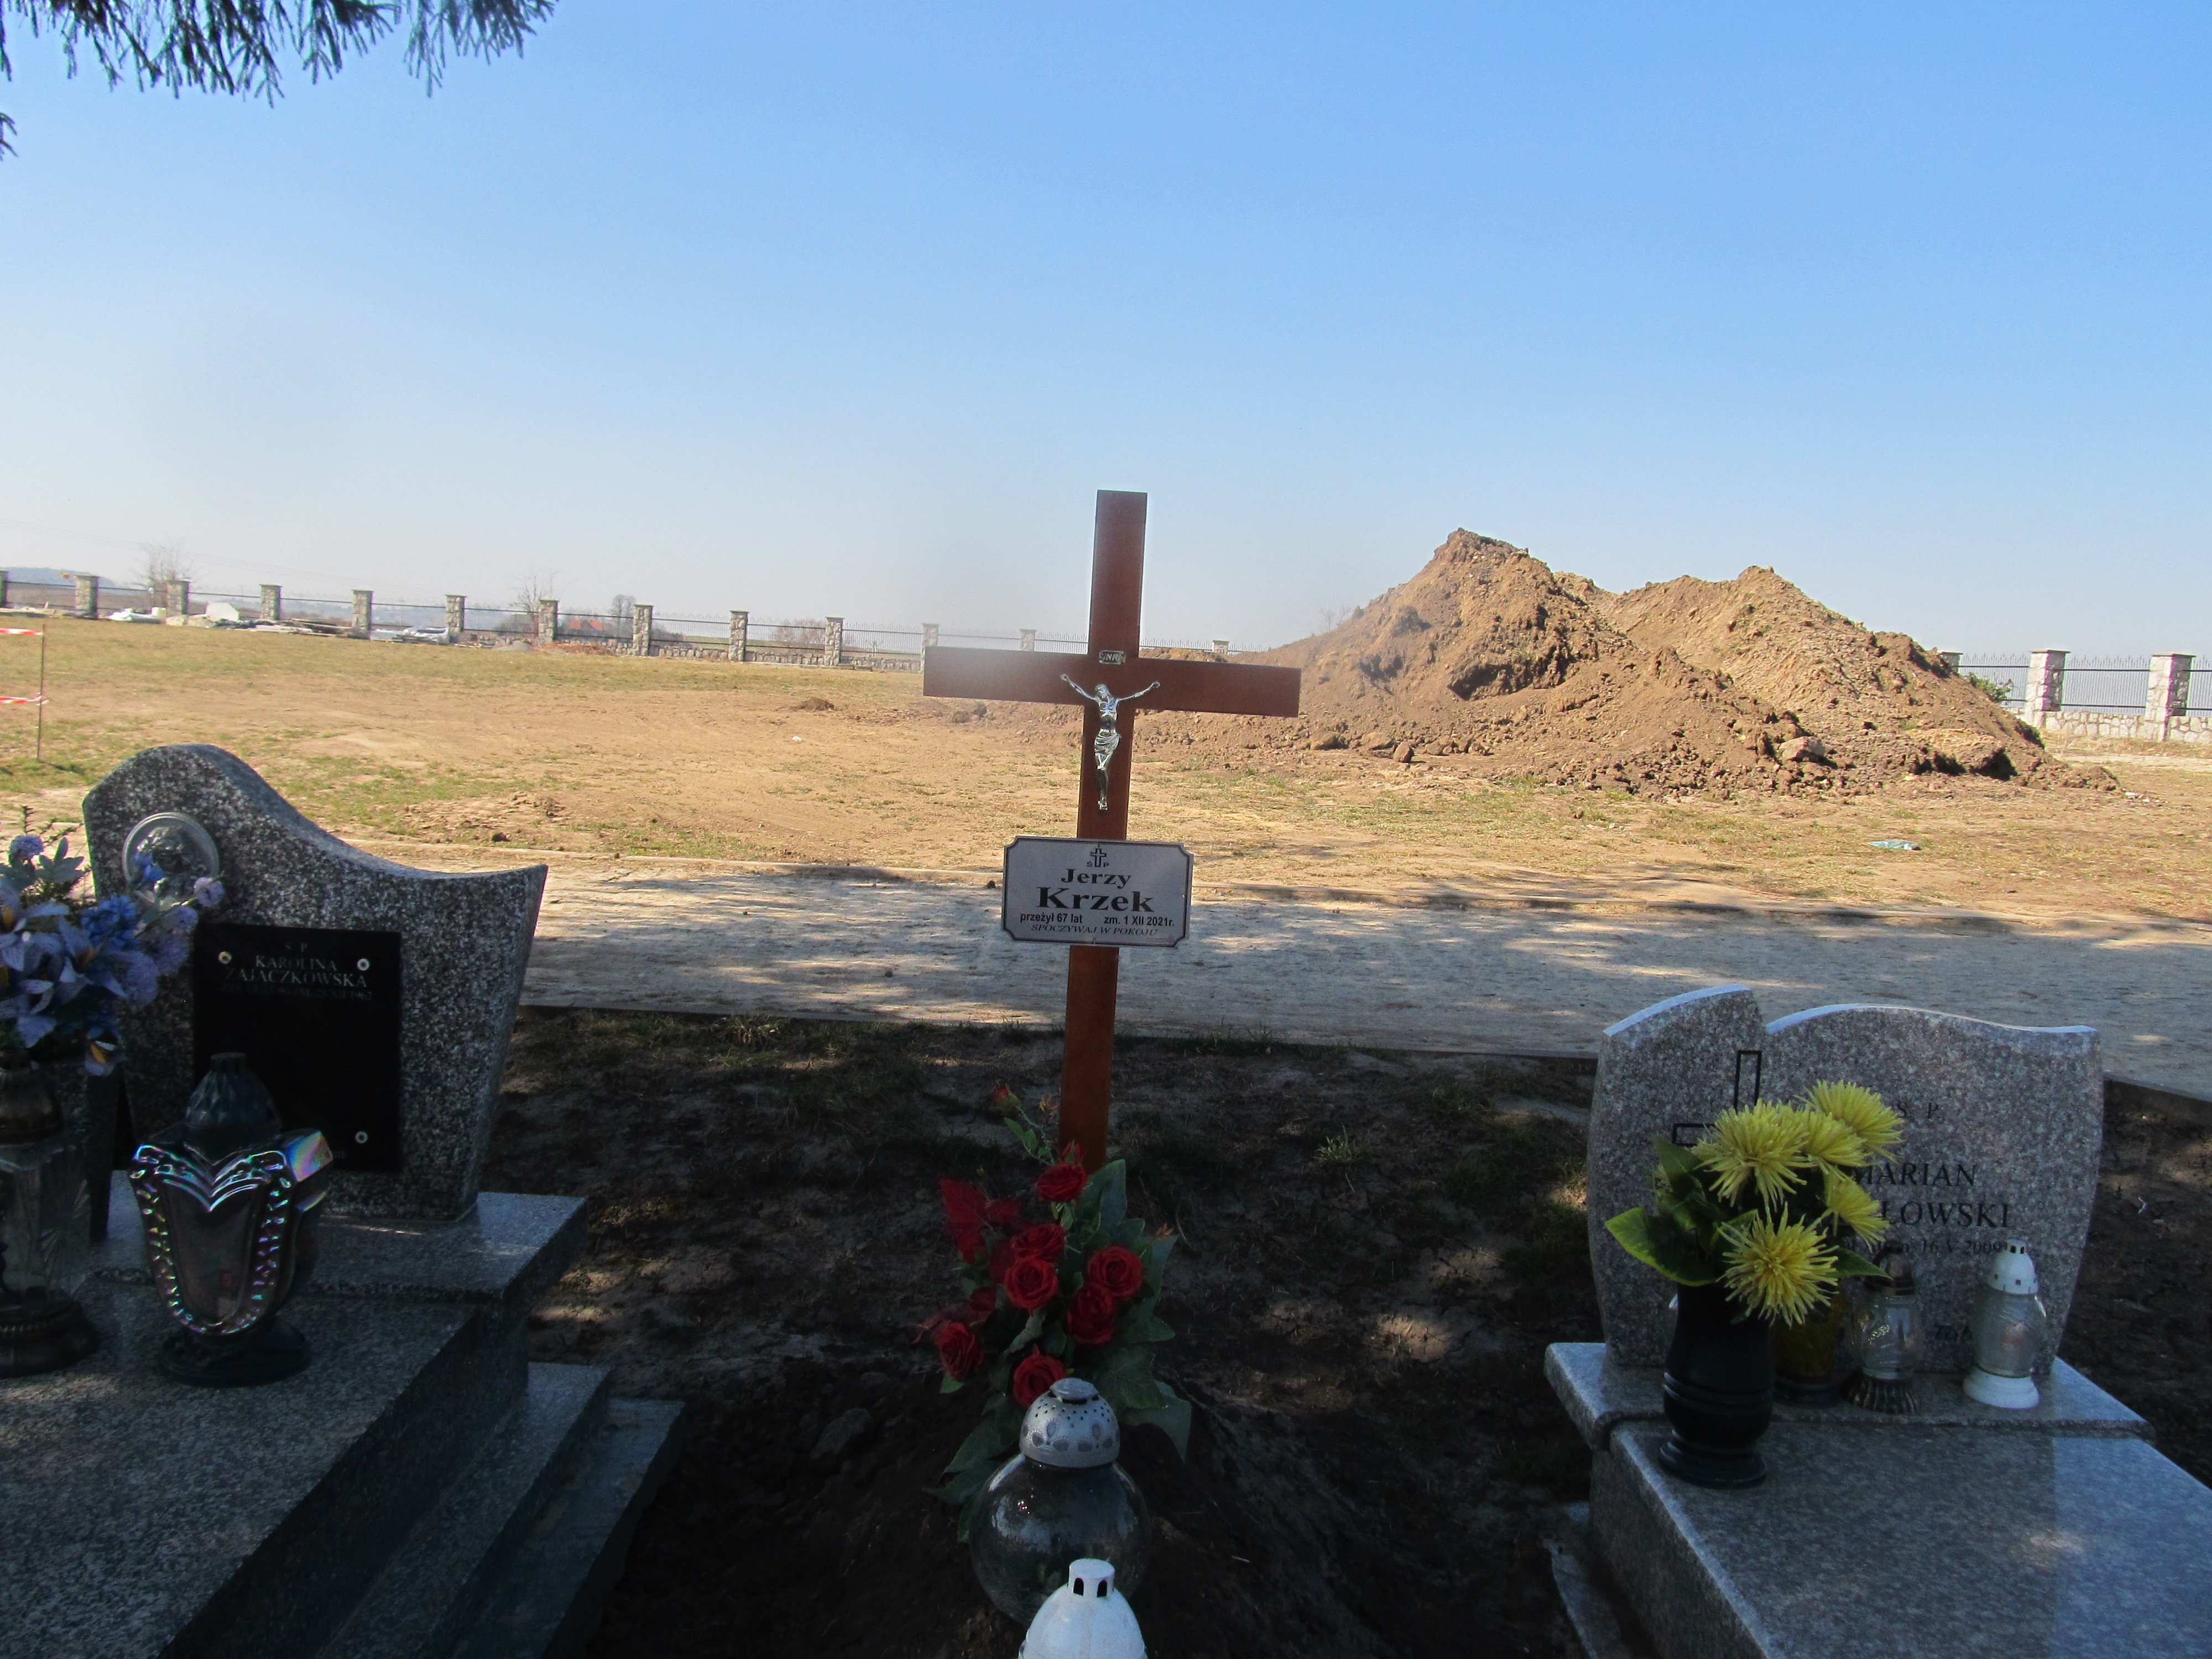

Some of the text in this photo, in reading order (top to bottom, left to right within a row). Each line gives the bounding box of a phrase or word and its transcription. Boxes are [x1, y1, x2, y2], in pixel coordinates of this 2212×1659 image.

[1061, 868, 1132, 889] Jerzy
[1036, 886, 1154, 912] Krzek
[1020, 912, 1055, 923] przeżył
[1057, 913, 1068, 922] 67
[1071, 913, 1083, 923] lat
[1124, 916, 1128, 925] 1
[1131, 916, 1144, 925] XII
[1146, 917, 1175, 927] 2021r.
[1031, 924, 1097, 933] SPOCZYWAJ
[1113, 927, 1159, 936] POKOJU
[255, 954, 338, 972] KAROLINA
[1927, 1102, 1939, 1118] P
[1853, 1162, 1978, 1186] MARIAN
